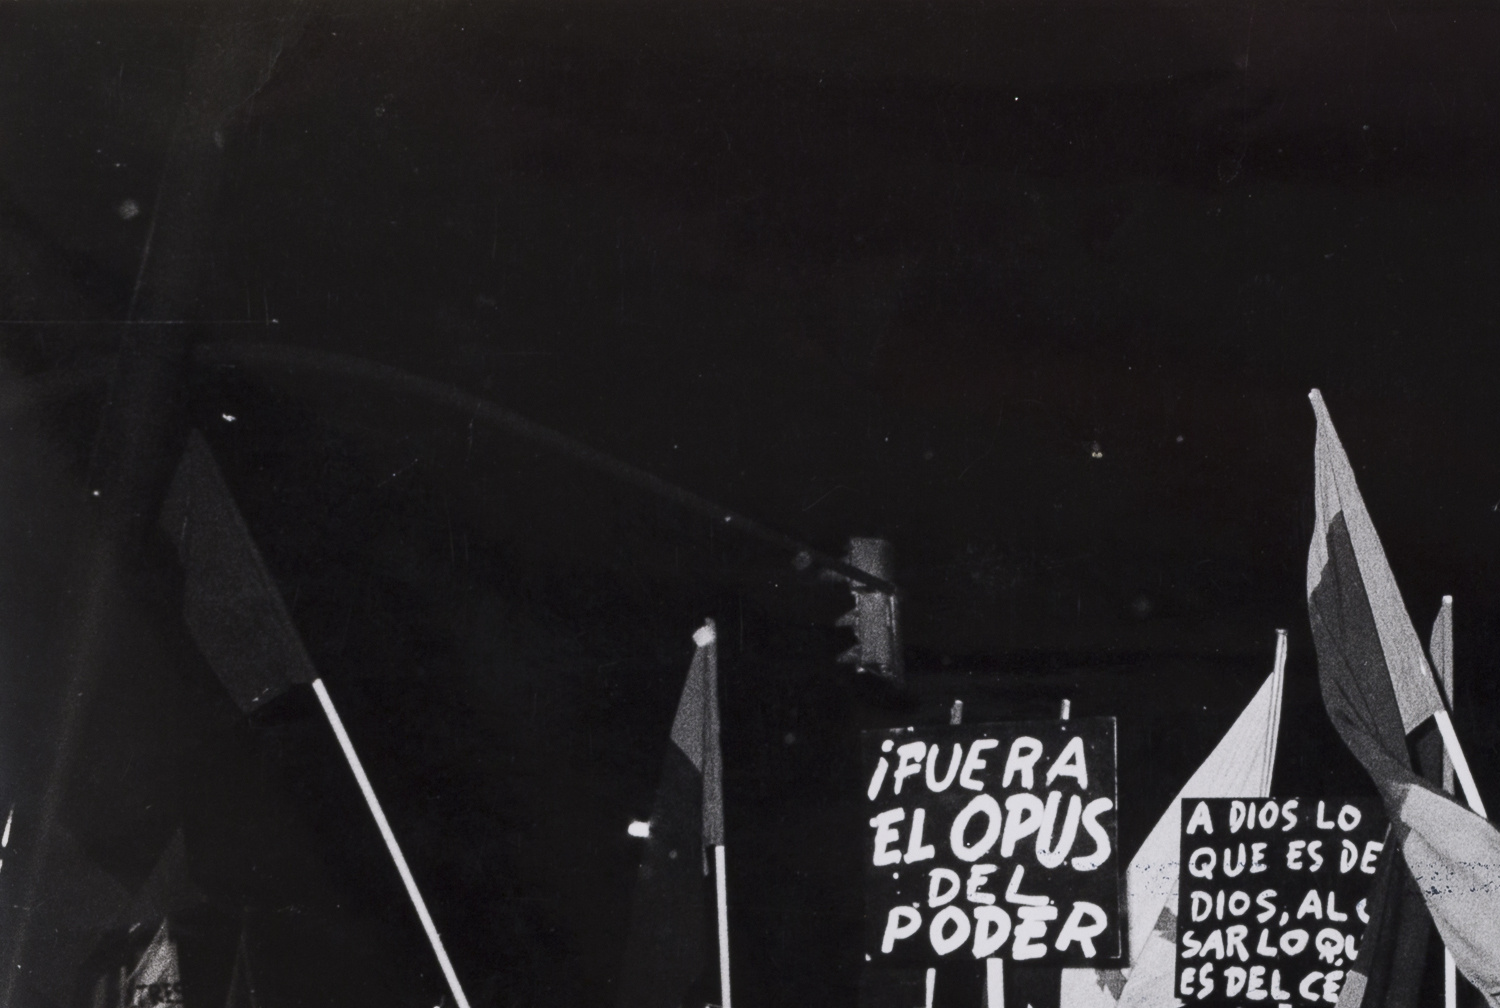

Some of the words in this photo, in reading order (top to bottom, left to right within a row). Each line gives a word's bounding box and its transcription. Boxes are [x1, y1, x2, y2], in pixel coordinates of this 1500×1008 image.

[867, 736, 1089, 801] ¡FUERA
[868, 806, 936, 867] EL
[949, 792, 1114, 872] OPUS
[1187, 801, 1214, 835] A
[1229, 799, 1299, 833] DIOS
[1316, 800, 1362, 832] LO
[1187, 841, 1268, 880] QUE
[1286, 839, 1324, 874] ES
[1339, 840, 1385, 875] DE
[927, 864, 1051, 909] DEL
[1190, 889, 1289, 927] DIOS,
[1297, 890, 1348, 922] AL
[880, 900, 1109, 961] PODER
[1181, 927, 1250, 962] SAR
[1256, 928, 1310, 957] LO
[1180, 966, 1216, 999] ES
[1222, 968, 1291, 1001] DEL
